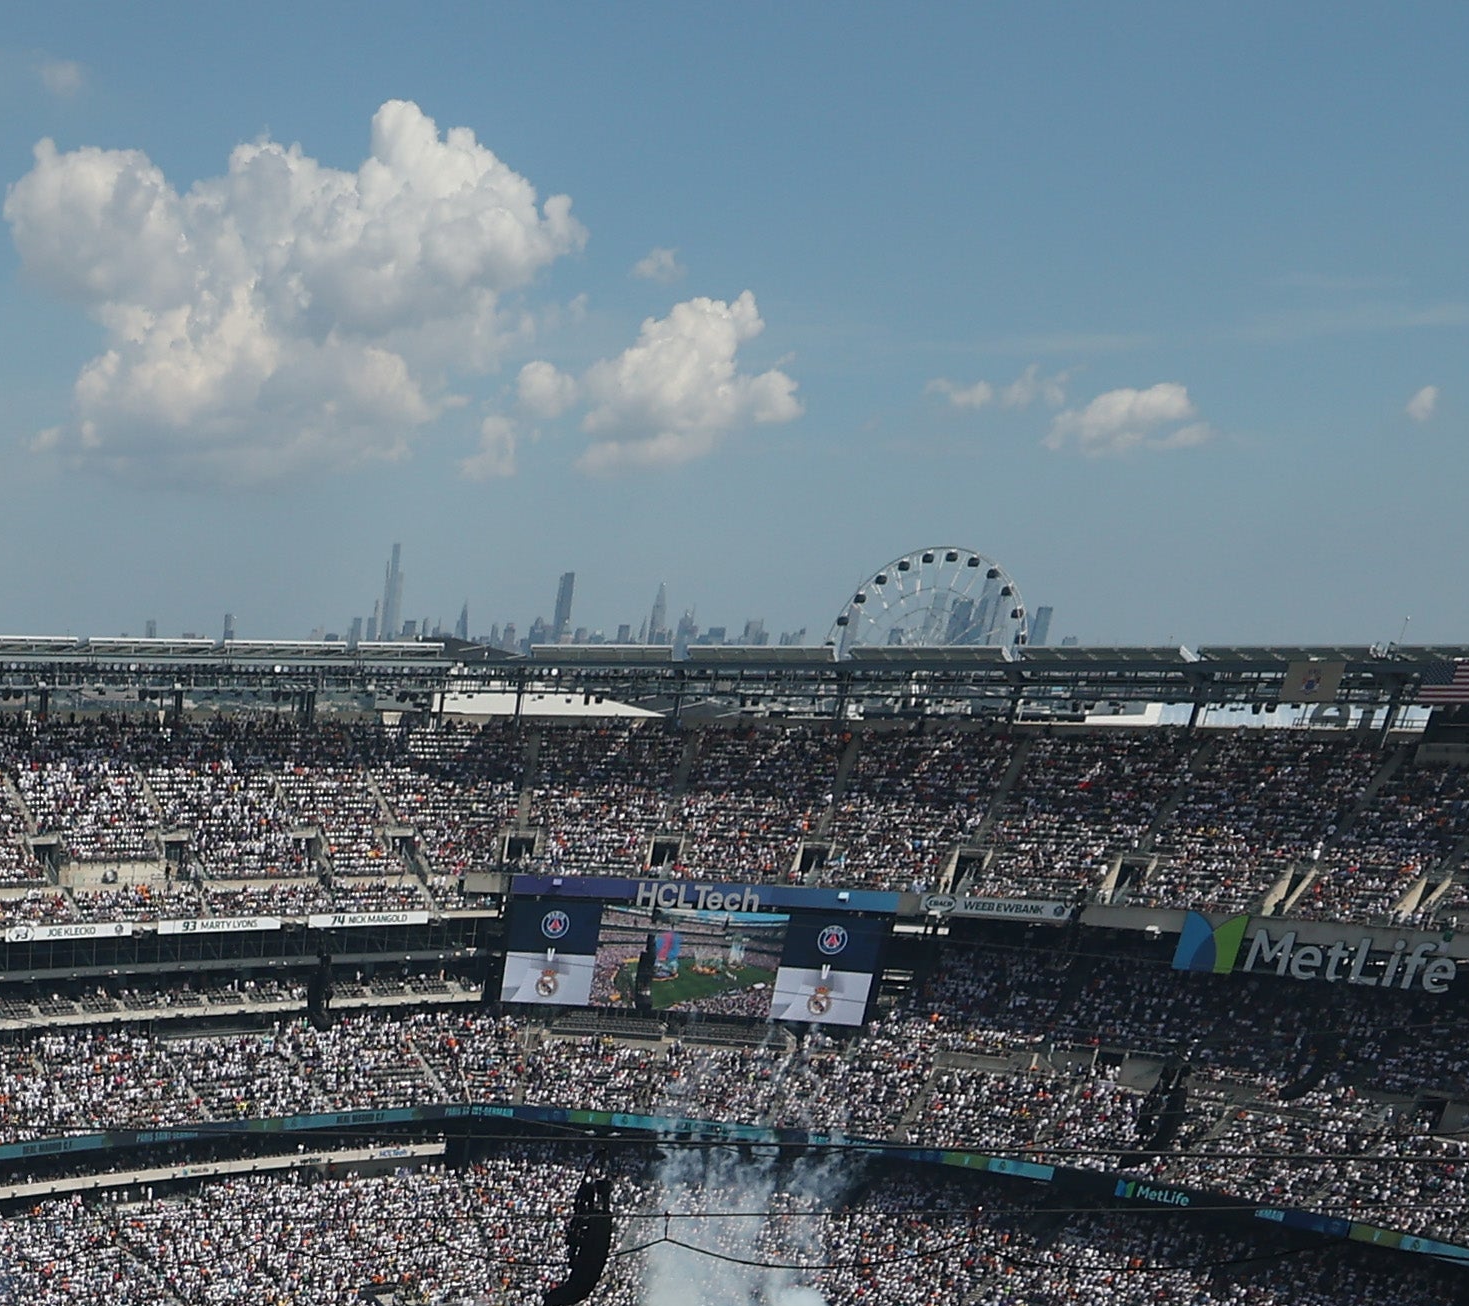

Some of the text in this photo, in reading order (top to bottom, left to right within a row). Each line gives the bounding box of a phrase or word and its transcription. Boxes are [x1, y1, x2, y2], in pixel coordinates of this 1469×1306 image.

[636, 882, 760, 912] HCLTech
[964, 902, 1044, 915] WEEB EWBANK
[182, 919, 258, 931] 93 MARTY LYONS
[331, 915, 345, 925] 74
[366, 914, 407, 923] MANGOLD
[47, 927, 63, 937] JOE
[64, 926, 96, 936] KLECKO
[1243, 929, 1456, 993] MetLife
[1136, 1186, 1190, 1207] MetLife
